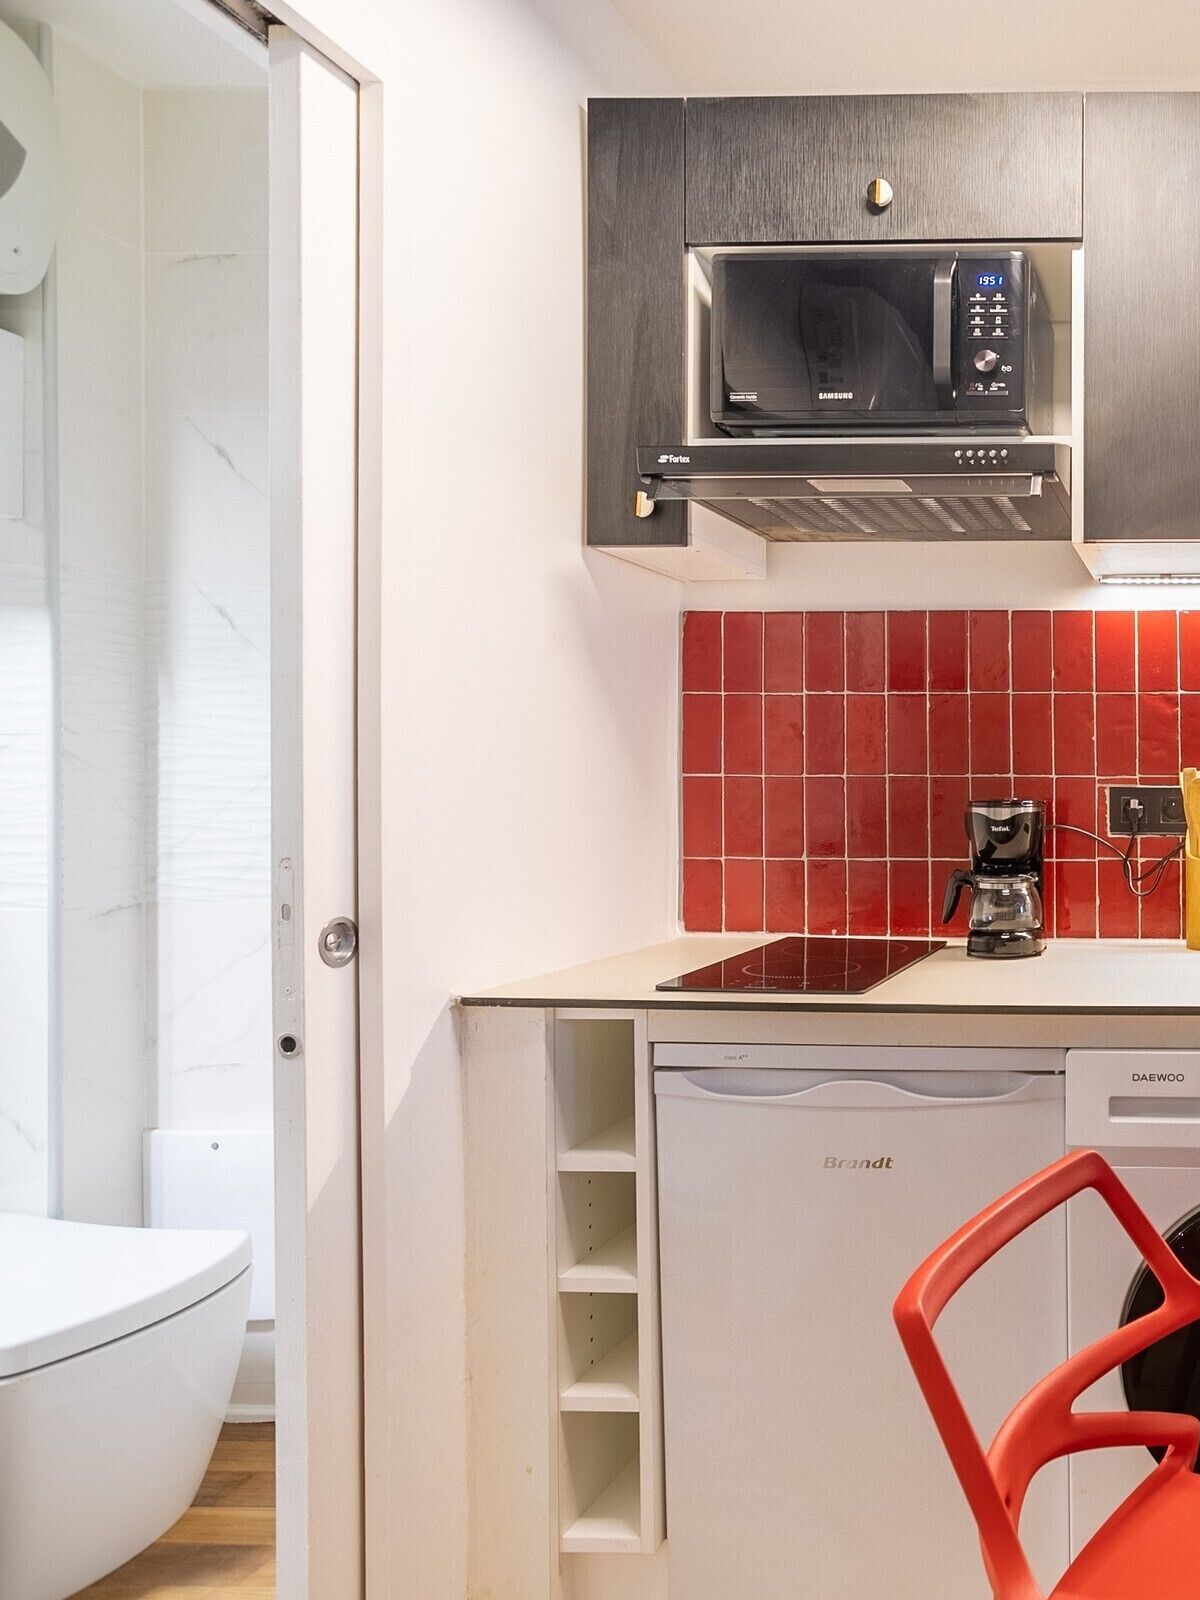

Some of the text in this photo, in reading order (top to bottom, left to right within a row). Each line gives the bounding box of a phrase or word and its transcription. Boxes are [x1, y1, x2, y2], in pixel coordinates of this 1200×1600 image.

[818, 392, 854, 400] SAMSUNG
[669, 455, 690, 463] Fortex
[1132, 1073, 1185, 1082] DAEWOO
[823, 1156, 894, 1170] Brandt
